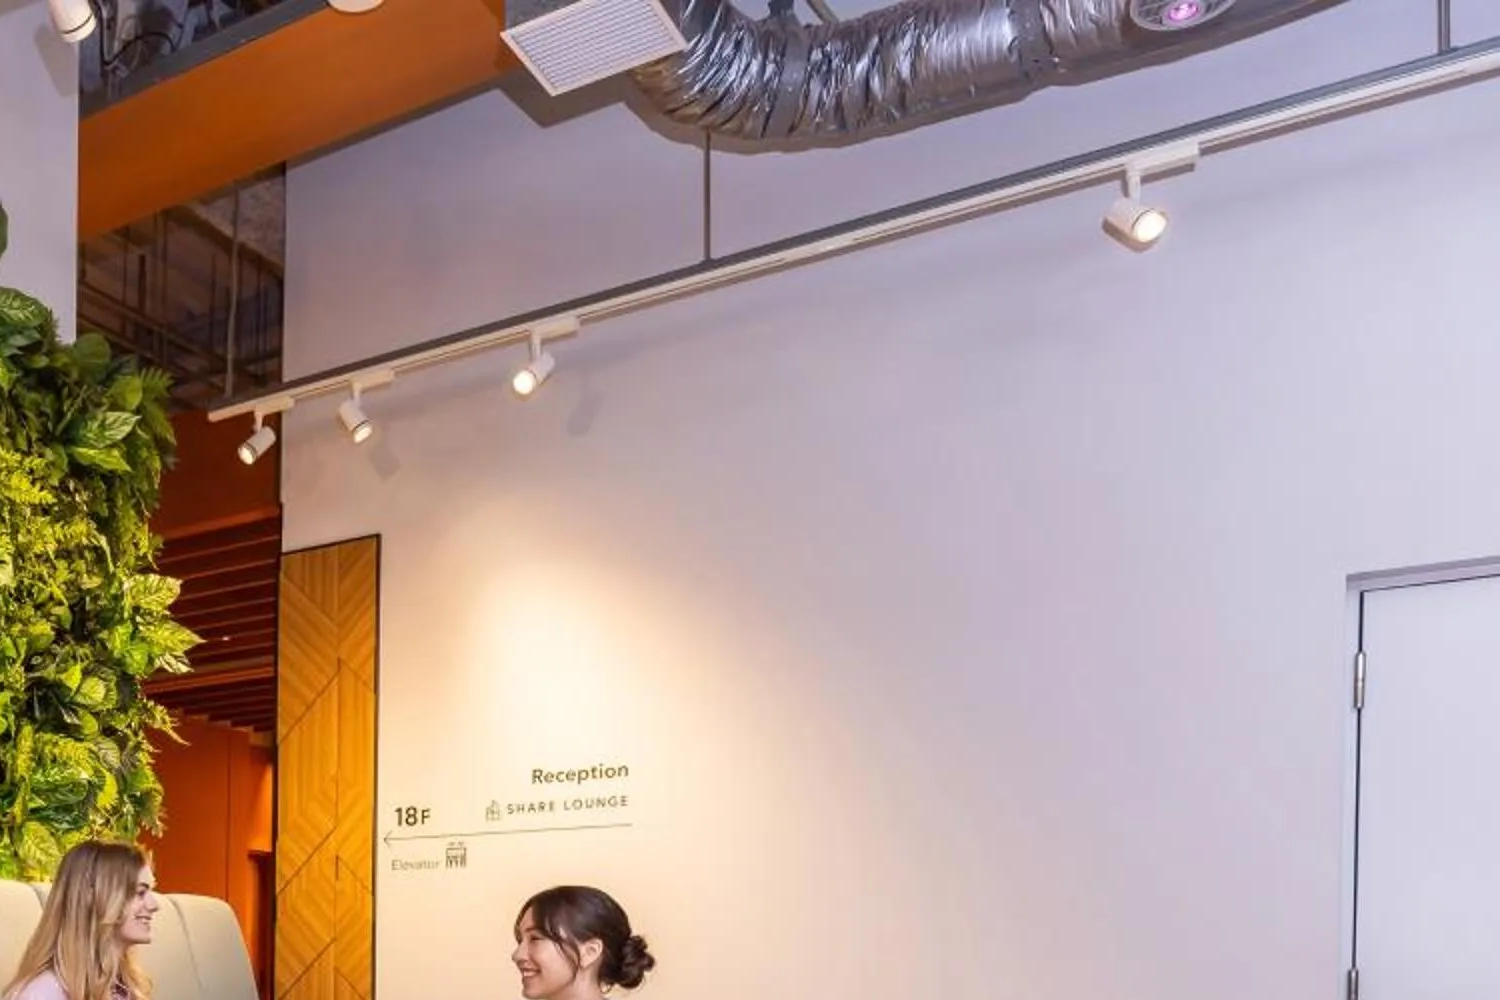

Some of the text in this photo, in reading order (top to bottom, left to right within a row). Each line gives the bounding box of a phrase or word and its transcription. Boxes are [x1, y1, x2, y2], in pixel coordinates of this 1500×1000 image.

[531, 764, 630, 785] Reception
[506, 795, 629, 815] SHARE LOUNGE
[394, 806, 432, 827] 18F
[391, 858, 440, 871] Elevator
